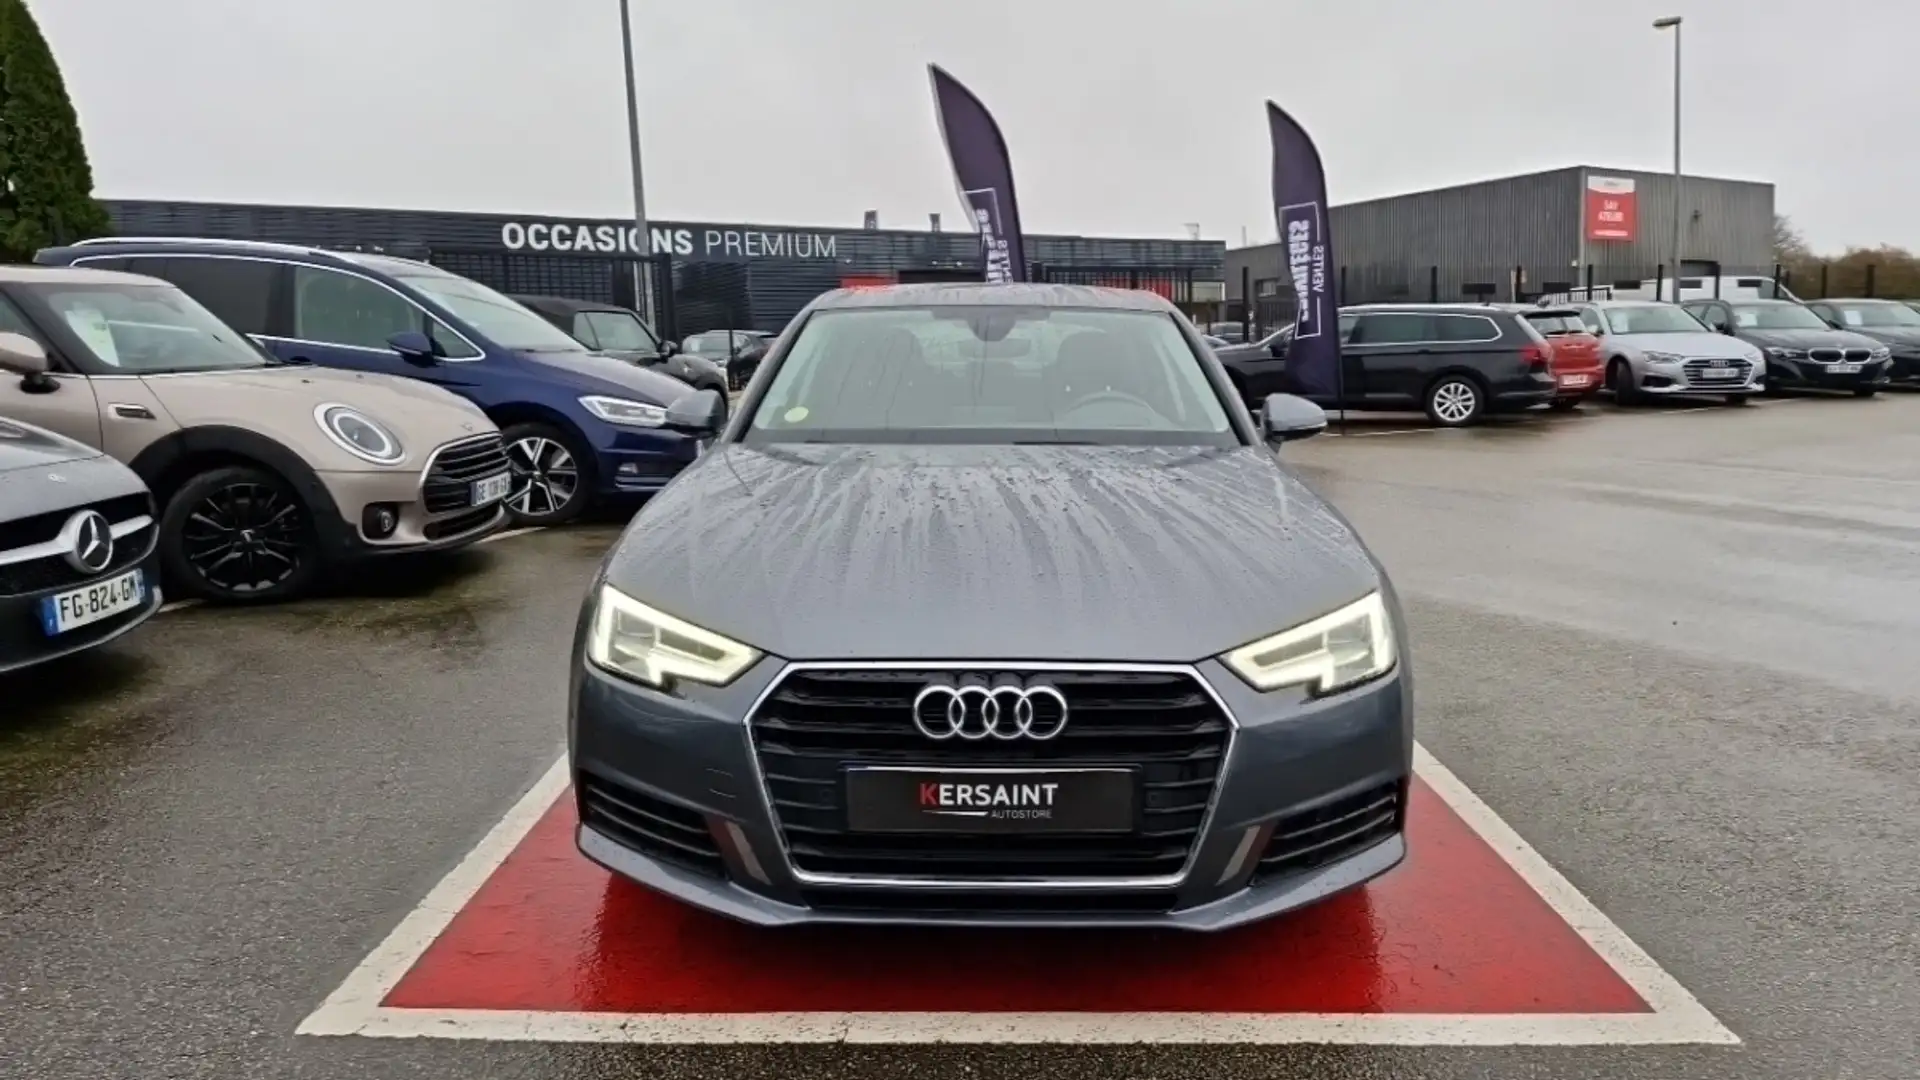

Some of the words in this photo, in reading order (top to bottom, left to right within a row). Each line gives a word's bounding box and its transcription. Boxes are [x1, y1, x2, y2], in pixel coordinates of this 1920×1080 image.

[705, 230, 836, 258] PREMIUM
[60, 576, 137, 622] FG-824-GM
[920, 783, 1059, 806] KERSAINT
[991, 809, 1052, 819] AUTOSTORE
